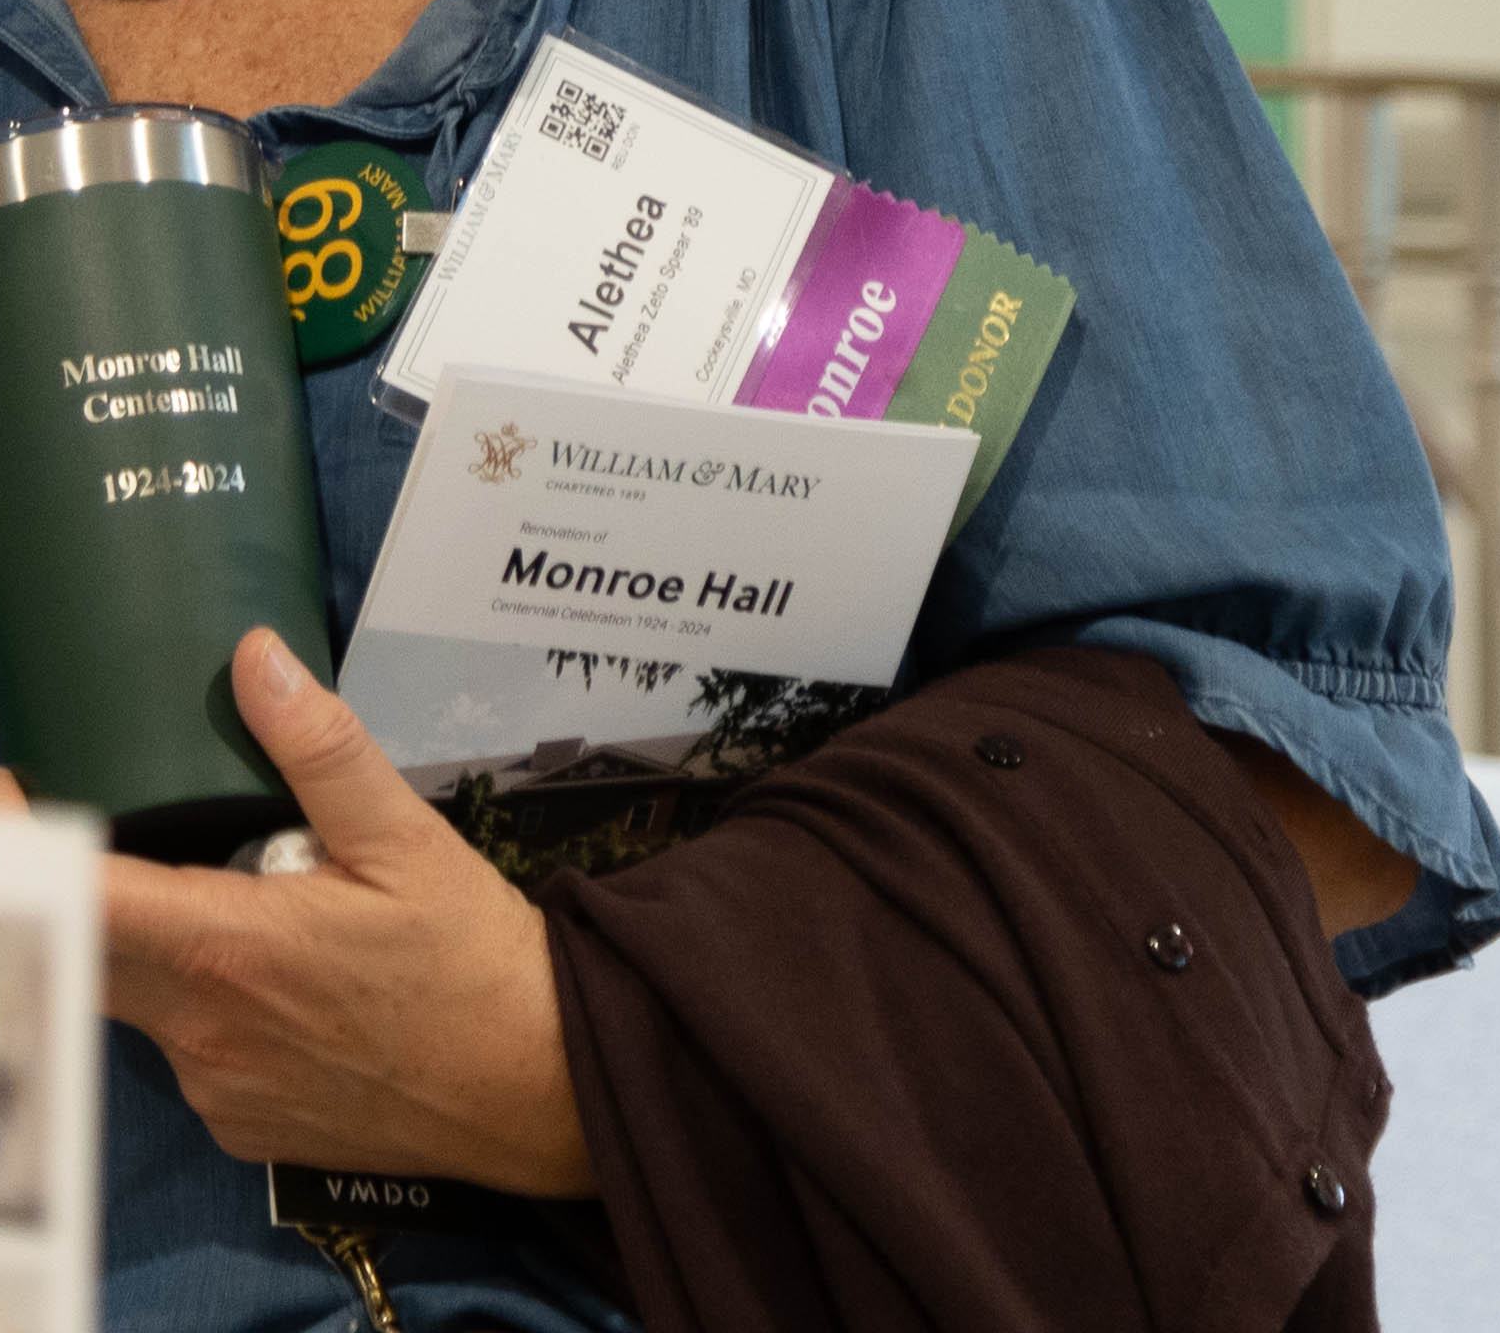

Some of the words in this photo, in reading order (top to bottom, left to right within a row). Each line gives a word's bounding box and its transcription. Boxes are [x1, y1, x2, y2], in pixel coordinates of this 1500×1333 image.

[357, 161, 408, 210] MARY
[438, 205, 490, 282] WILLIAM
[487, 127, 523, 181] MARY
[353, 237, 407, 322] WILLIA
[567, 193, 667, 356] Alethea
[612, 322, 652, 386] Alethea
[659, 231, 691, 280] Spear
[61, 348, 182, 388] Monroe
[187, 343, 244, 376] Hall
[807, 280, 897, 421] onroe
[946, 290, 1024, 426] DONOR
[83, 384, 238, 424] Centennial
[103, 460, 246, 504] 1924-2024
[545, 479, 615, 498] CHARTERED
[550, 440, 686, 483] WILLIAM
[691, 459, 726, 487] &
[725, 463, 822, 500] MARY
[519, 521, 591, 543] Renovation
[593, 530, 610, 544] of
[501, 547, 685, 604] Monroe
[697, 570, 795, 617] Hall
[491, 597, 560, 619] Centennial
[561, 606, 632, 628] Celebration
[636, 614, 668, 632] 1924
[678, 619, 712, 636] 2024
[326, 1177, 430, 1208] VMDO
